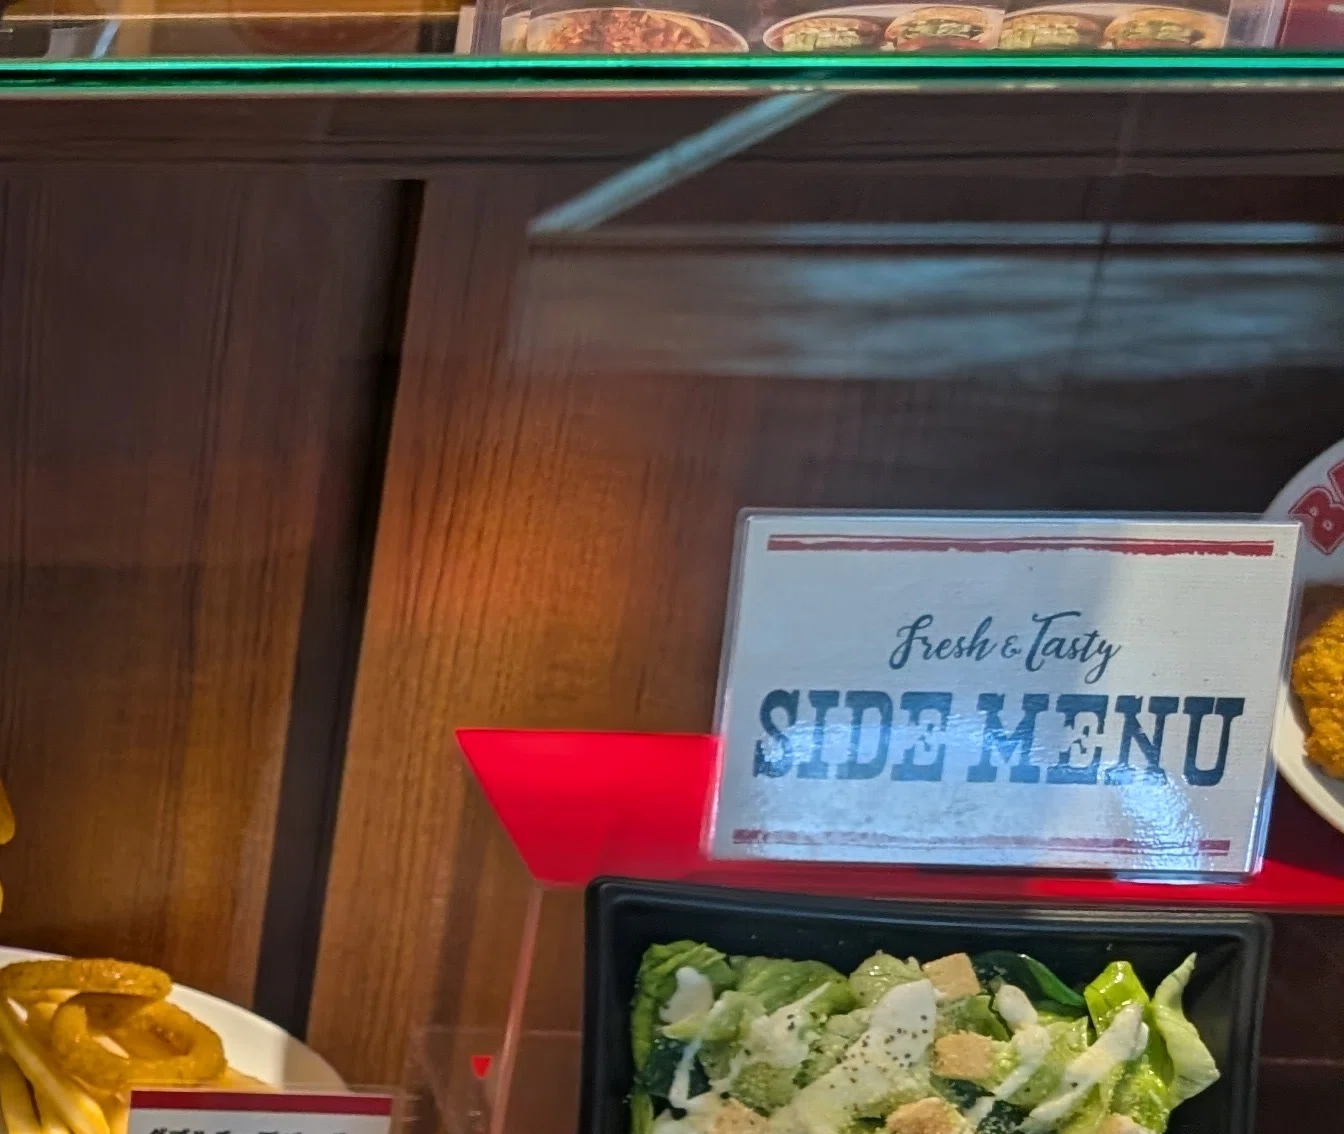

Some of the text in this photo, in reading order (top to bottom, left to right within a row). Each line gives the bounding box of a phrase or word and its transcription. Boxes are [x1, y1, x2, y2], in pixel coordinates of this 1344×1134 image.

[888, 612, 999, 671] Fresh
[1025, 610, 1123, 685] Tasty
[752, 687, 1246, 787] SIDE MENU
